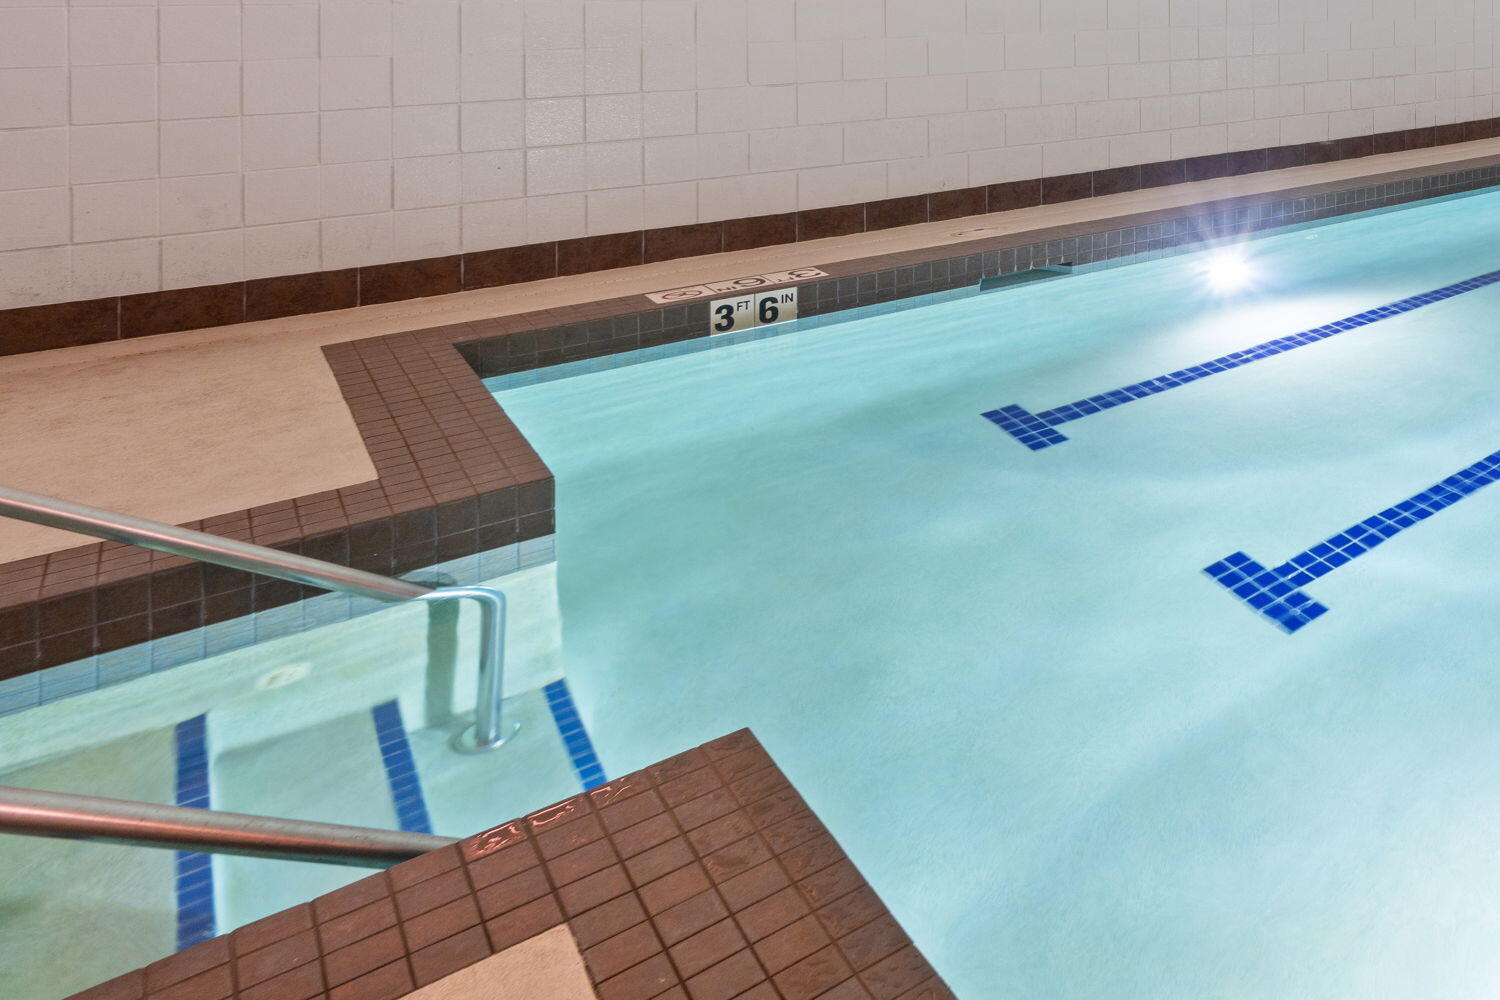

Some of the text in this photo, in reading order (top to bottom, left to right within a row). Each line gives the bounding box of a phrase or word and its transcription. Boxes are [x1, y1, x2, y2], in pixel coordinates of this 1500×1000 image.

[788, 268, 822, 278] 3
[714, 293, 794, 332] 3 FT 6 IN
